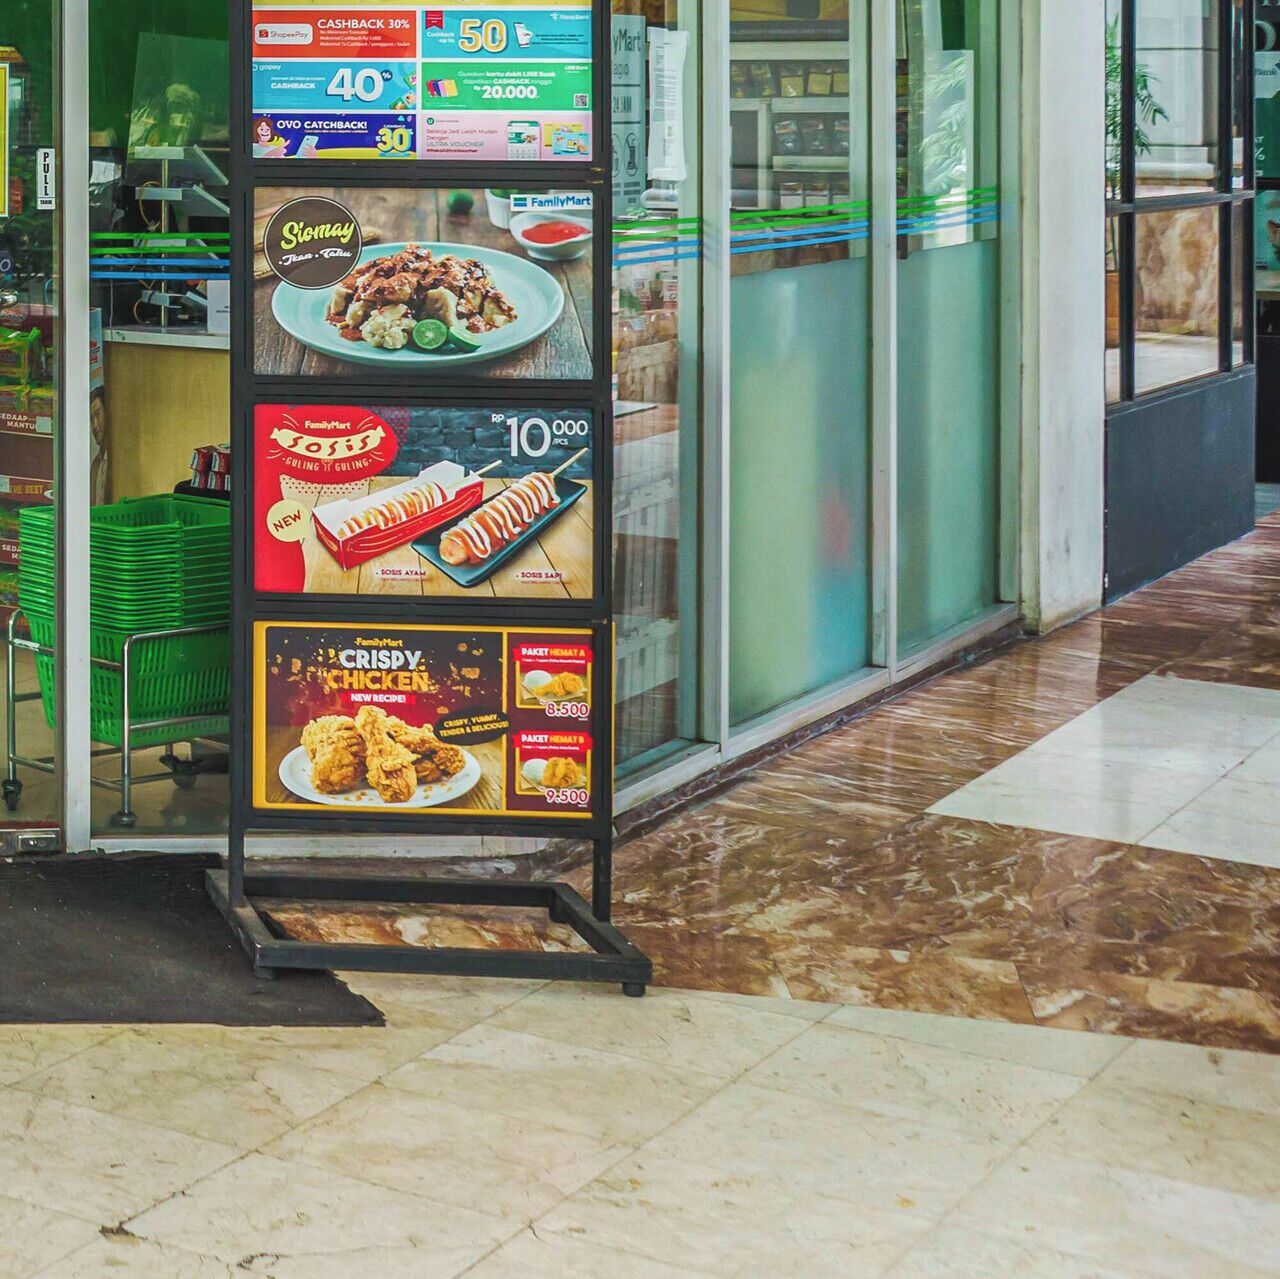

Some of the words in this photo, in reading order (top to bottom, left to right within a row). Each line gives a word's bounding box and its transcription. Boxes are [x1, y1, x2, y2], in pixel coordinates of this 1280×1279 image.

[317, 19, 384, 29] CASHBACK
[388, 19, 410, 29] 30%
[270, 31, 308, 39] ShopeePay
[459, 19, 506, 52] 50
[613, 29, 641, 55] yMart
[327, 68, 384, 101] 40
[277, 120, 301, 129] OVO
[304, 121, 367, 129] CATCHBACK!
[378, 128, 411, 151] 30
[41, 152, 50, 197] PULL
[531, 195, 592, 208] FamilyMart
[280, 221, 356, 251] Siomay
[305, 420, 351, 430] FamilyMart
[492, 414, 504, 423] RP
[552, 420, 588, 436] 000
[506, 417, 551, 457] 10
[285, 457, 319, 470] GULING
[335, 458, 368, 471] GULING
[273, 510, 301, 532] NEW
[355, 637, 403, 647] FamilyMart
[339, 649, 422, 670] CRISPY
[521, 648, 548, 656] PAKET
[327, 669, 429, 690] CHICKEN
[351, 692, 372, 702] NEW
[373, 693, 406, 703] RECIPE!
[546, 702, 589, 717] 8.500
[444, 719, 469, 727] CRISPY,
[471, 714, 500, 724] YUMMY,
[440, 729, 465, 737] TENDER
[472, 721, 509, 734] DELICIOUS!
[545, 790, 589, 803] 9.500
